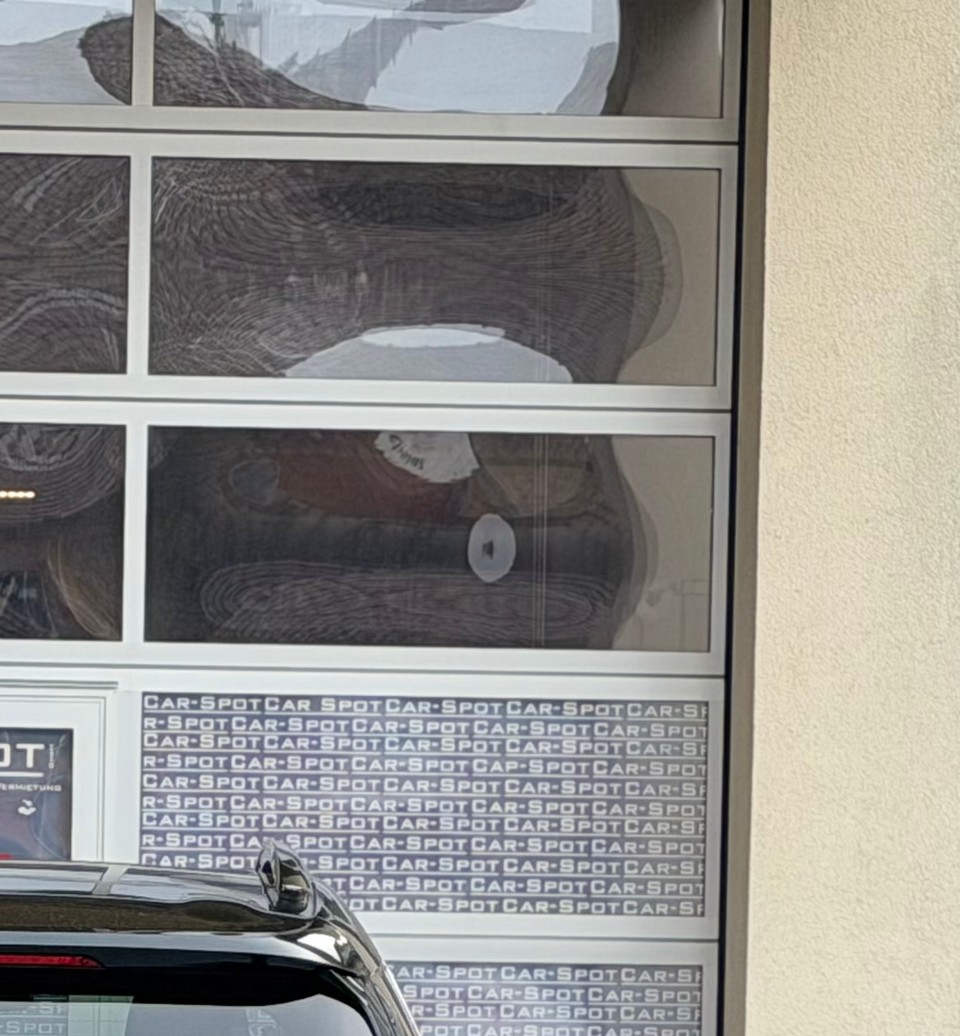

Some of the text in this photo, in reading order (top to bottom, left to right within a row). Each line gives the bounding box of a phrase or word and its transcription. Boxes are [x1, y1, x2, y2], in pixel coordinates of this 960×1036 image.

[144, 695, 624, 716] CAR-SPOT CAR-SPOT CAR-SPOT
[231, 716, 349, 731] CAR-SPOT
[352, 718, 470, 733] CAR-SPOT
[473, 720, 590, 735] CAR-SPOT
[143, 732, 623, 754] CAR-SPOT CAR-SPOT CAR-SPOT CAR-SPOT
[231, 753, 348, 769] CAR-SPOT
[351, 756, 469, 771] CAR-SPOT
[142, 772, 622, 795] CAR-SPOT CAR-SPOT CAR-SPOT CAR-SPOT
[230, 794, 347, 809] CAR-SPOT
[350, 797, 468, 812] CAR-SPOT
[471, 799, 588, 814] CAR-SPOT
[142, 811, 621, 832] CAR-SPOT CAR-SPOT CAR-SPOT CAR-SPOT
[349, 835, 467, 850] CAR-SPOT
[470, 837, 588, 852] CAR-SPOT
[382, 856, 500, 871] CAR-SPOT
[503, 858, 621, 873] CAR-SPOT
[348, 875, 467, 890] CAR-SPOT
[470, 878, 587, 893] CAR-SPOT
[381, 897, 620, 913] CAR-SPOT CAR-SPOT
[500, 967, 618, 980] CAR-SPOT
[467, 986, 584, 1000] CAR-SPOT
[499, 1004, 617, 1019] CAR-SPOT
